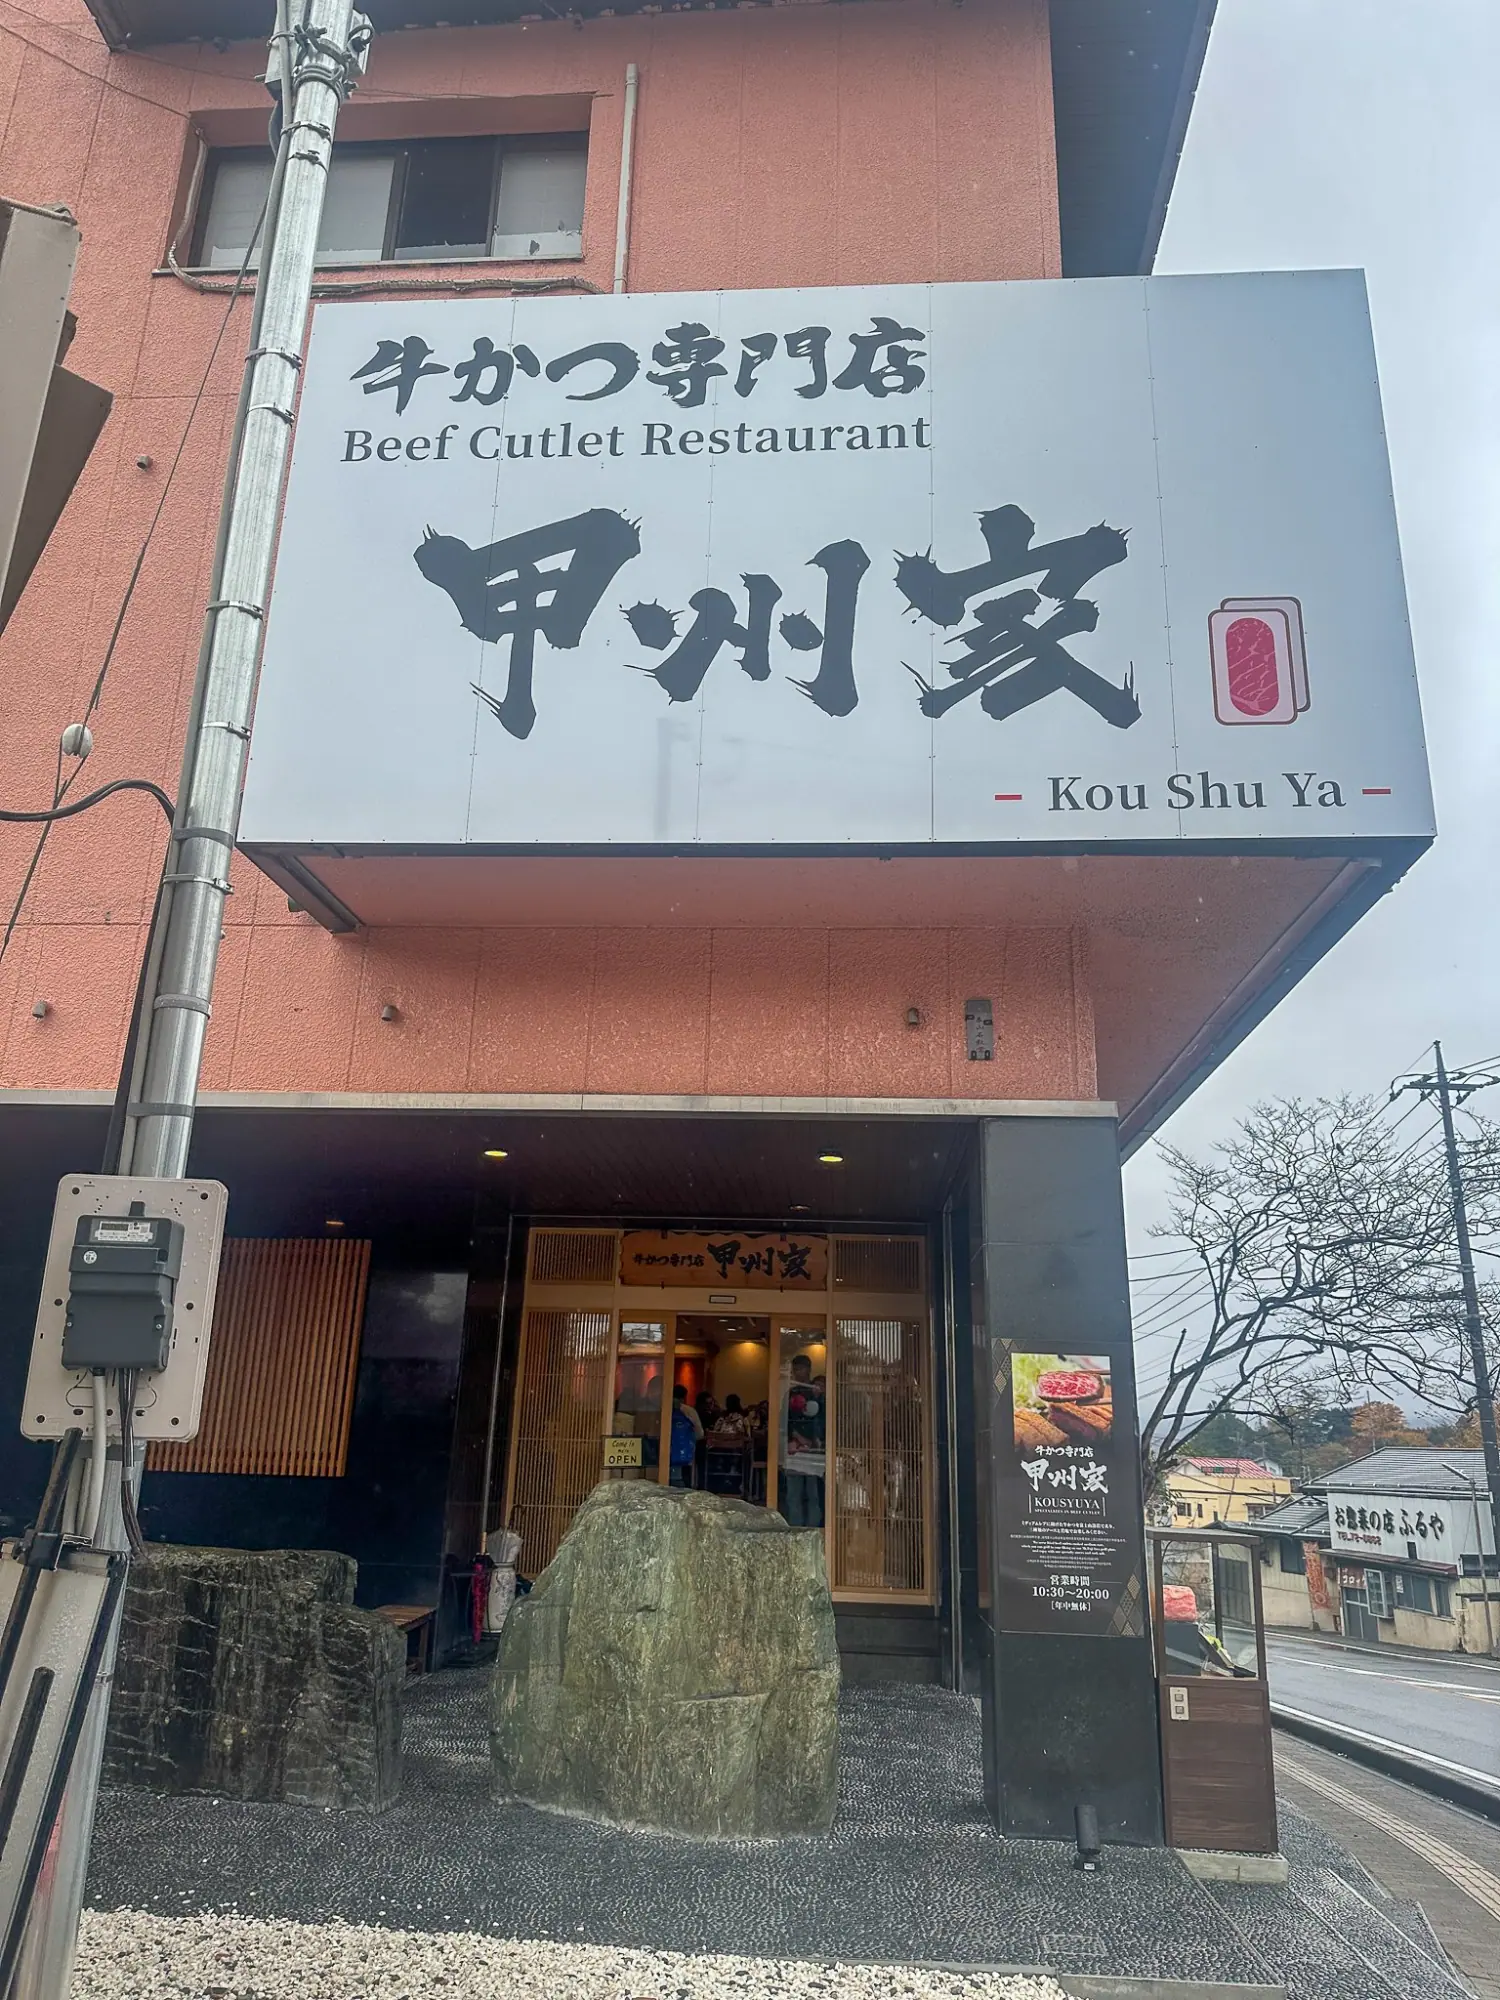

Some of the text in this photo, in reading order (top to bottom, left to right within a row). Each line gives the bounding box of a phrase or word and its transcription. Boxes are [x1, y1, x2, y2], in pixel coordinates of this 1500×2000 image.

[350, 317, 928, 413] 牛かつ専門店
[340, 418, 931, 462] Beef Cutlet Restaurant
[413, 504, 1142, 739] 甲州家
[1048, 771, 1347, 811] Kou Shu Ya
[707, 1240, 812, 1280] 甲州家
[608, 1455, 637, 1464] OPEN
[1034, 1445, 1094, 1458] 牛かつ専門店
[1020, 1458, 1109, 1494] 甲州家
[1034, 1497, 1100, 1509] KOUSYUYA
[1399, 1508, 1445, 1540] ふるや
[1050, 1574, 1090, 1586] 営業時間
